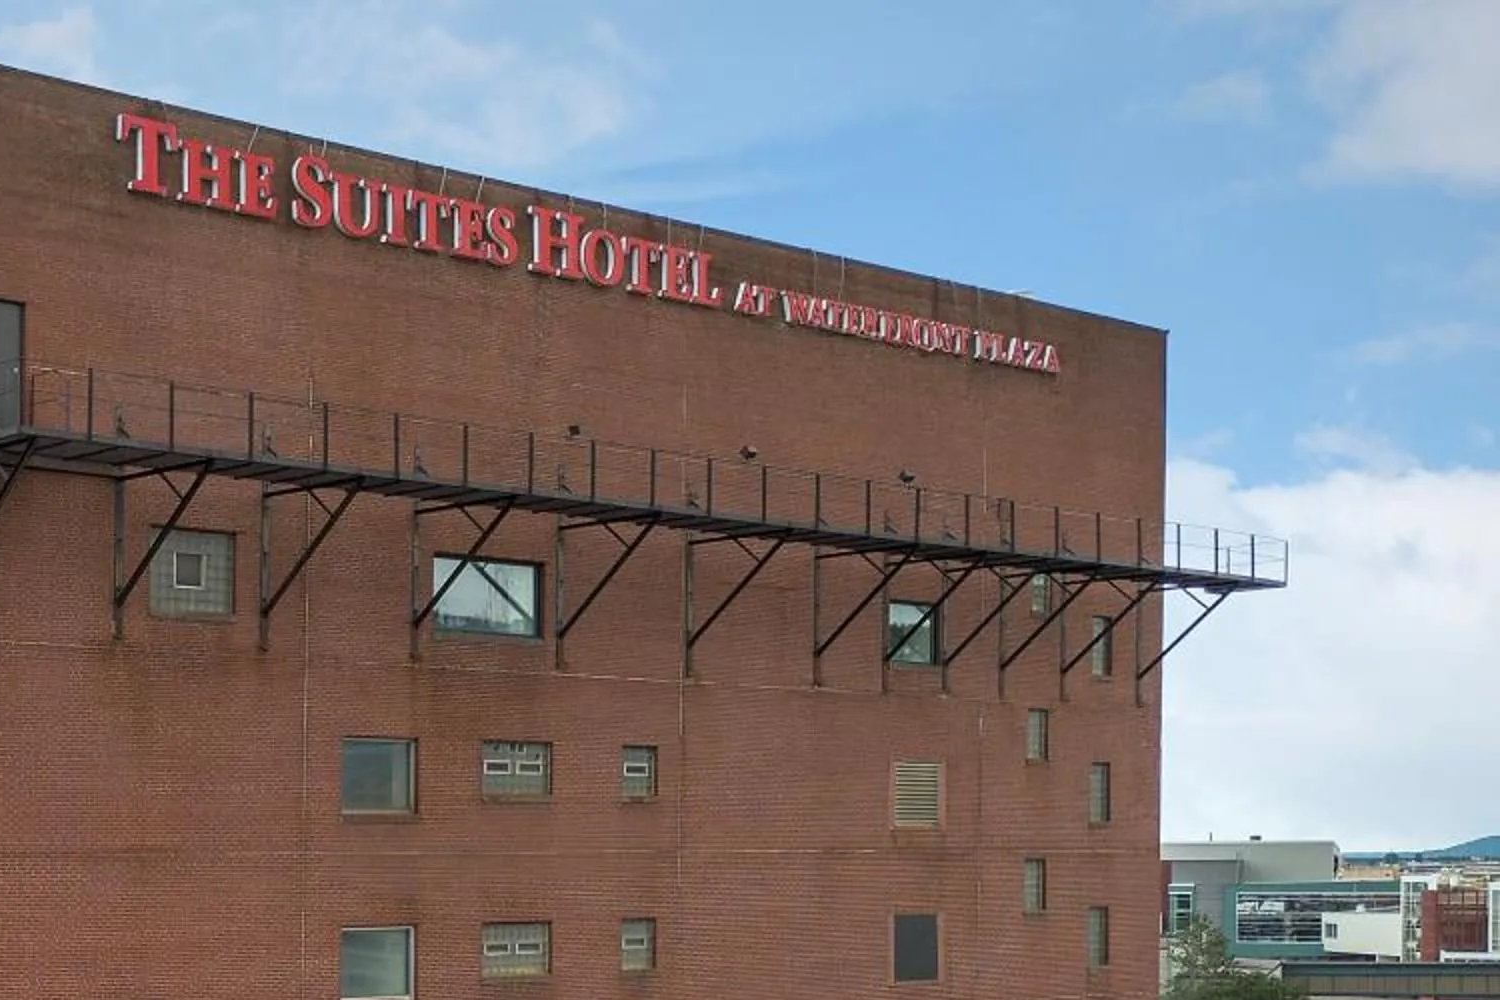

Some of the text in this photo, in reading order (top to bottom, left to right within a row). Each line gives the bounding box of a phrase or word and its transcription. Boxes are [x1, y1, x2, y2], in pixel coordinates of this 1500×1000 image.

[116, 111, 1061, 373] THE SUITES HOTEL AT WATERFRONT PLAZA
